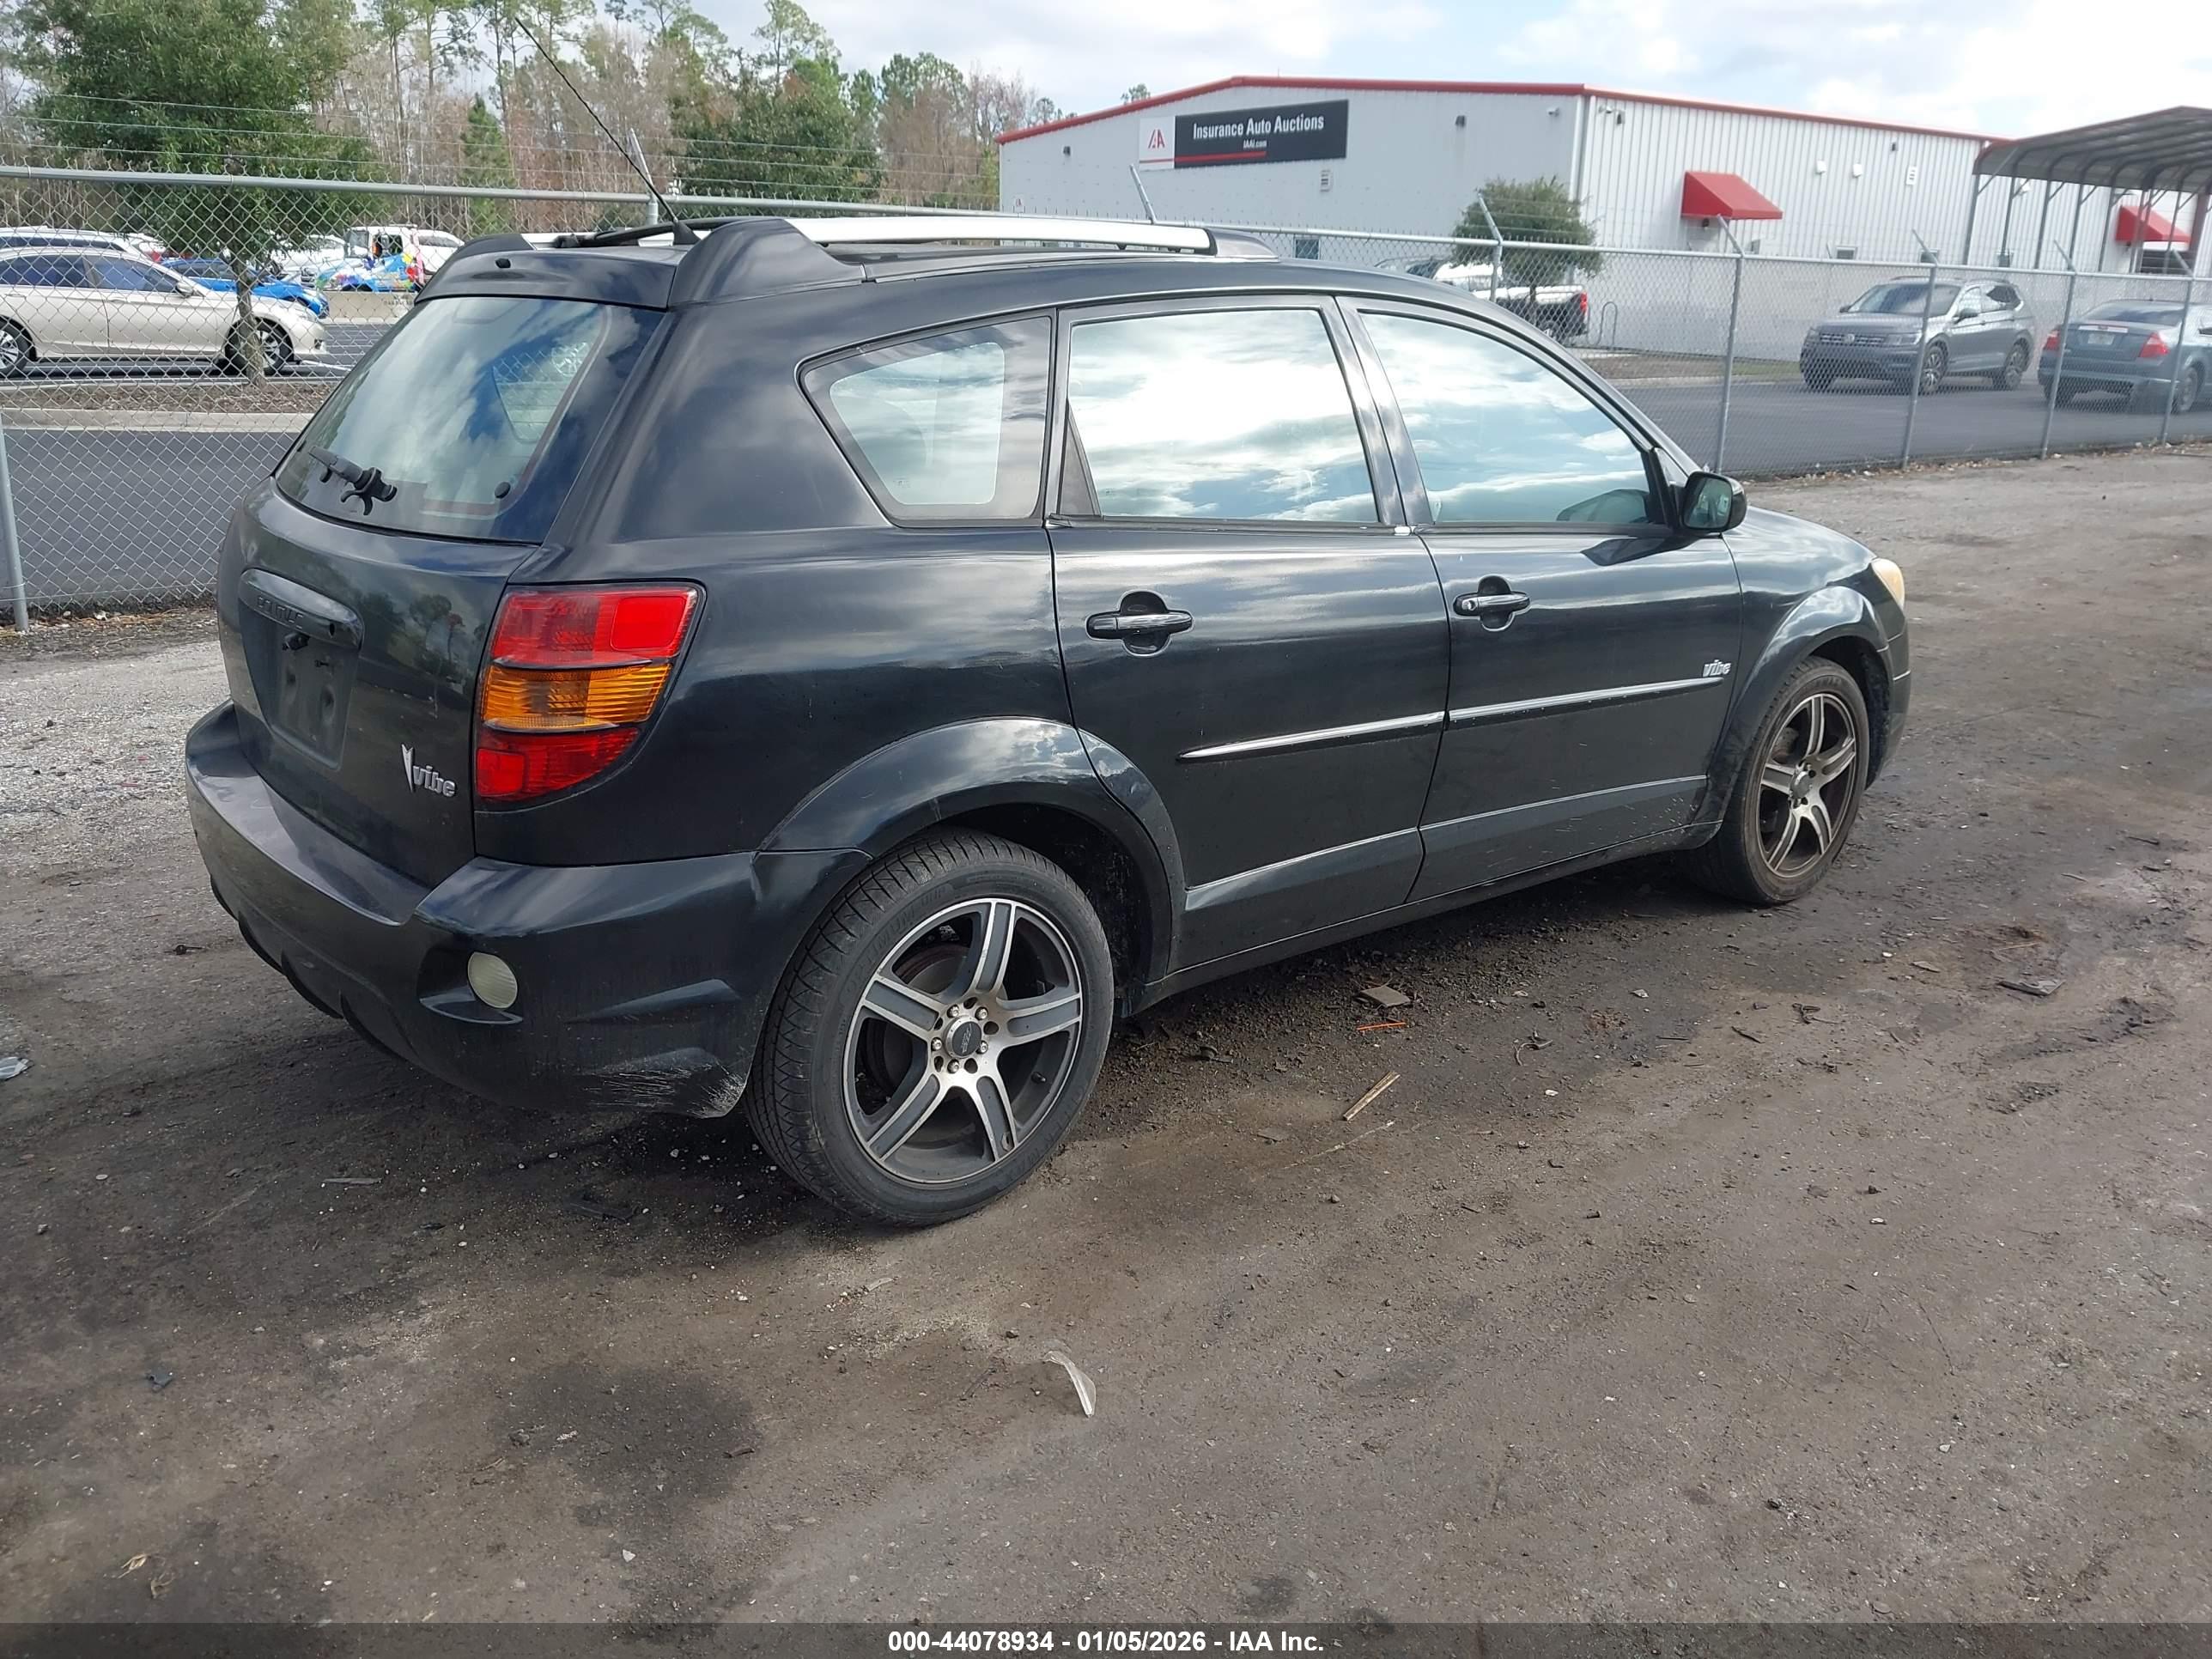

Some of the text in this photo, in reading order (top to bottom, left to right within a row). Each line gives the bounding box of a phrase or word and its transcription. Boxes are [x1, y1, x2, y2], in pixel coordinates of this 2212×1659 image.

[1193, 112, 1325, 140] Insurance Auto Auctions
[1702, 659, 1732, 678] vibe
[412, 764, 456, 798] vibe
